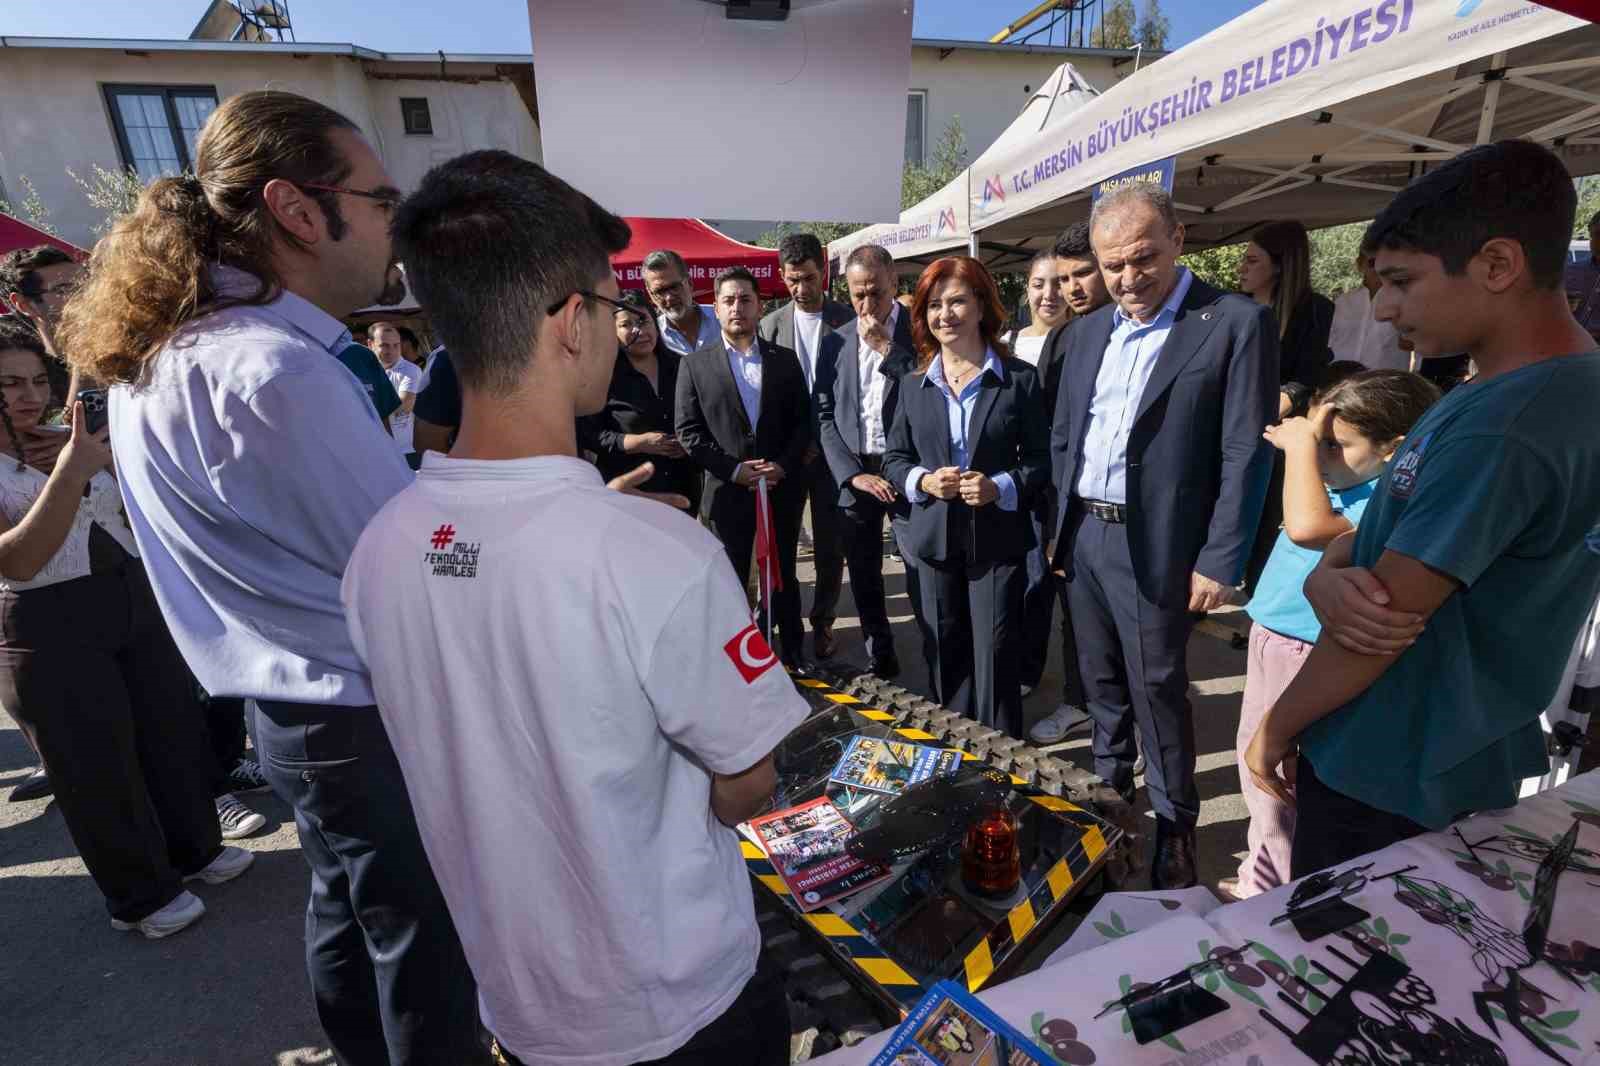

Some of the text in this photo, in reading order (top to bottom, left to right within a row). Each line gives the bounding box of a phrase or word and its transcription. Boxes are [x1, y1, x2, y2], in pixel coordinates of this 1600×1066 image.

[1013, 172, 1032, 193] T.C.
[1033, 140, 1083, 183] MERSİN
[1088, 76, 1212, 159] BÜYÜKŞEHİR
[432, 565, 477, 578] HAMLESİ
